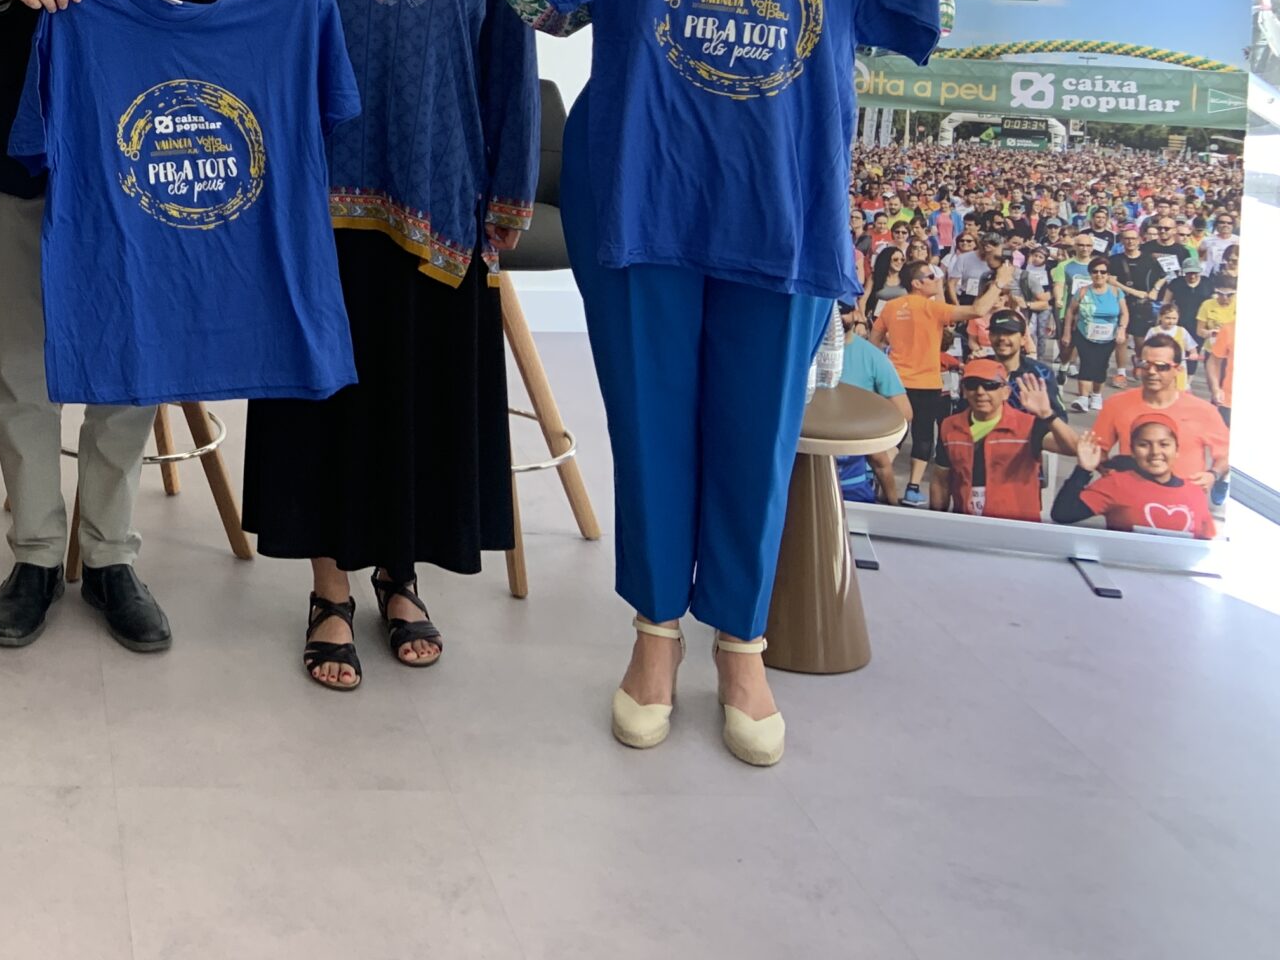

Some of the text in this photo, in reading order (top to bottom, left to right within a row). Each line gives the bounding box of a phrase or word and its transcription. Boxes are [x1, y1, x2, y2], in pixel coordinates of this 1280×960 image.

[684, 15, 718, 39] PER
[742, 22, 788, 50] TOTS
[729, 44, 773, 67] peus
[854, 71, 997, 106] olta a peu
[1063, 76, 1138, 94] caixa
[1061, 93, 1181, 113] popular
[175, 114, 205, 123] caixa
[175, 121, 222, 132] popular
[195, 135, 222, 146] Volta
[148, 161, 176, 184] PER
[196, 157, 237, 179] TOTS
[194, 179, 225, 203] peus
